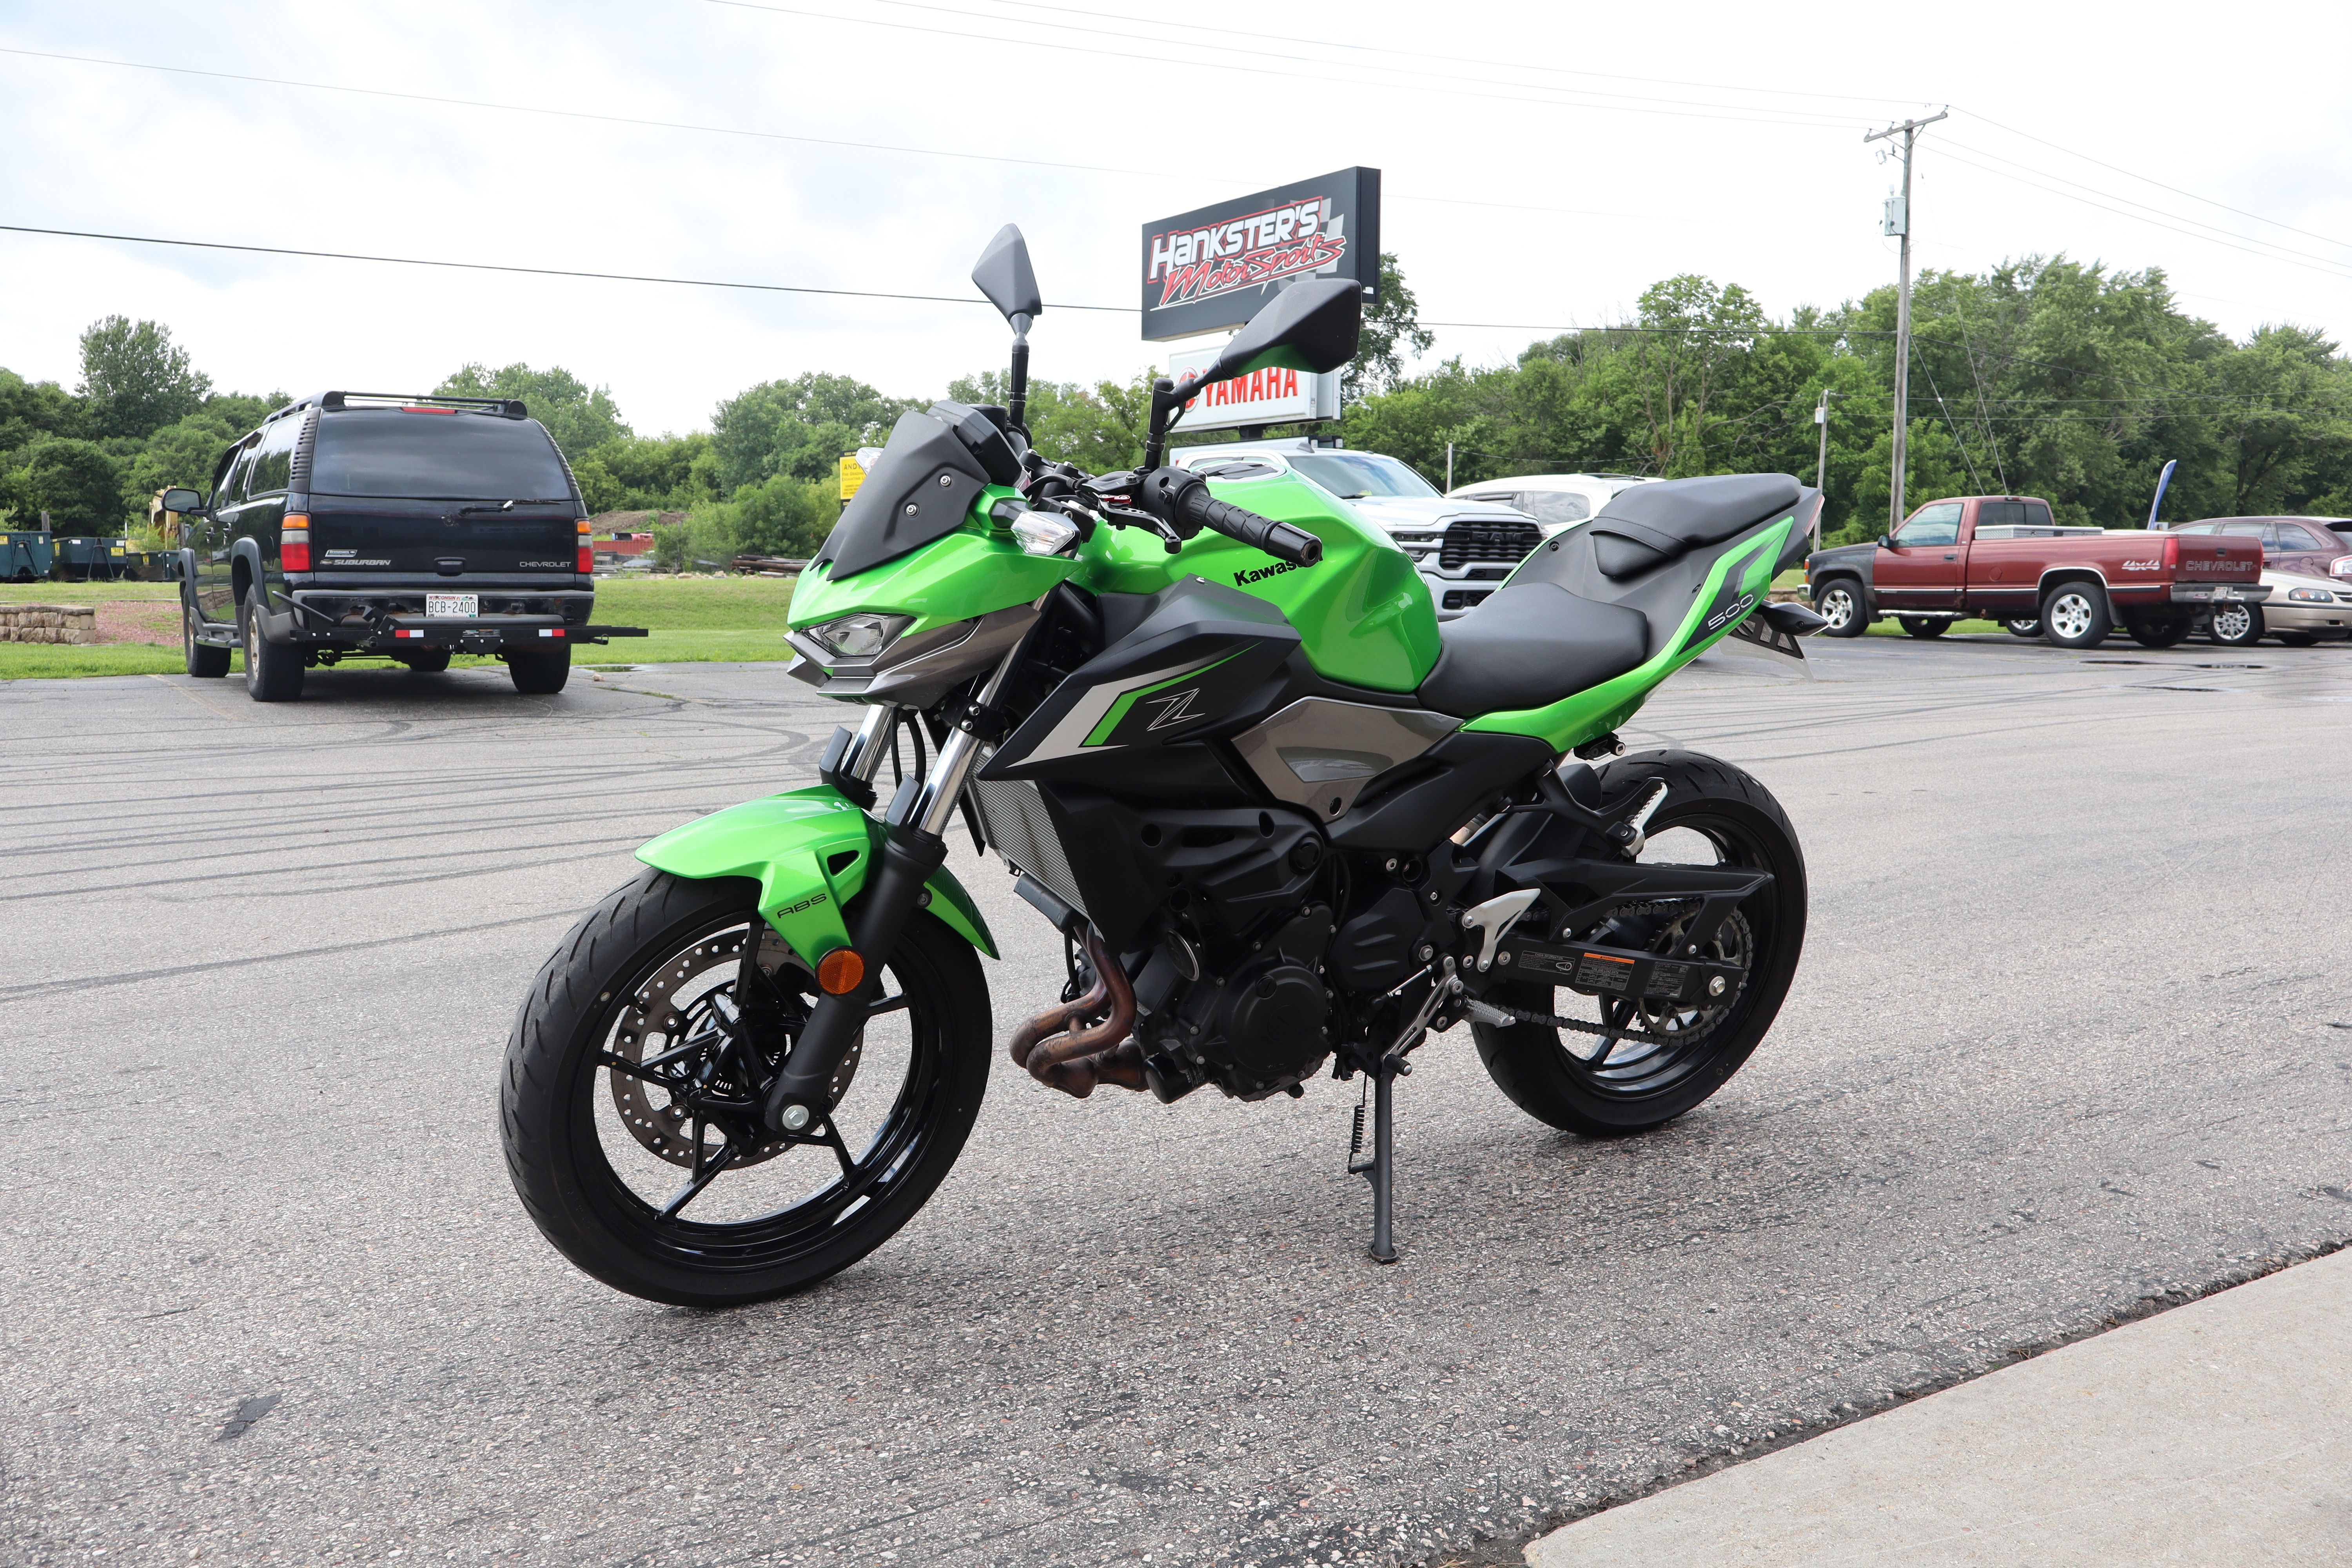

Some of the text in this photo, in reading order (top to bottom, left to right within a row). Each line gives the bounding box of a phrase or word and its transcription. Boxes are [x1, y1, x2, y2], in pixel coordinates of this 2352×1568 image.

[1202, 367, 1298, 407] YAMAHA
[1472, 532, 1522, 541] RAM
[1233, 554, 1323, 587] Kawas
[2186, 561, 2253, 571] CHEVROLET
[429, 601, 476, 613] BCB-2400
[1708, 594, 1754, 630] 500
[777, 893, 827, 919] ABS
